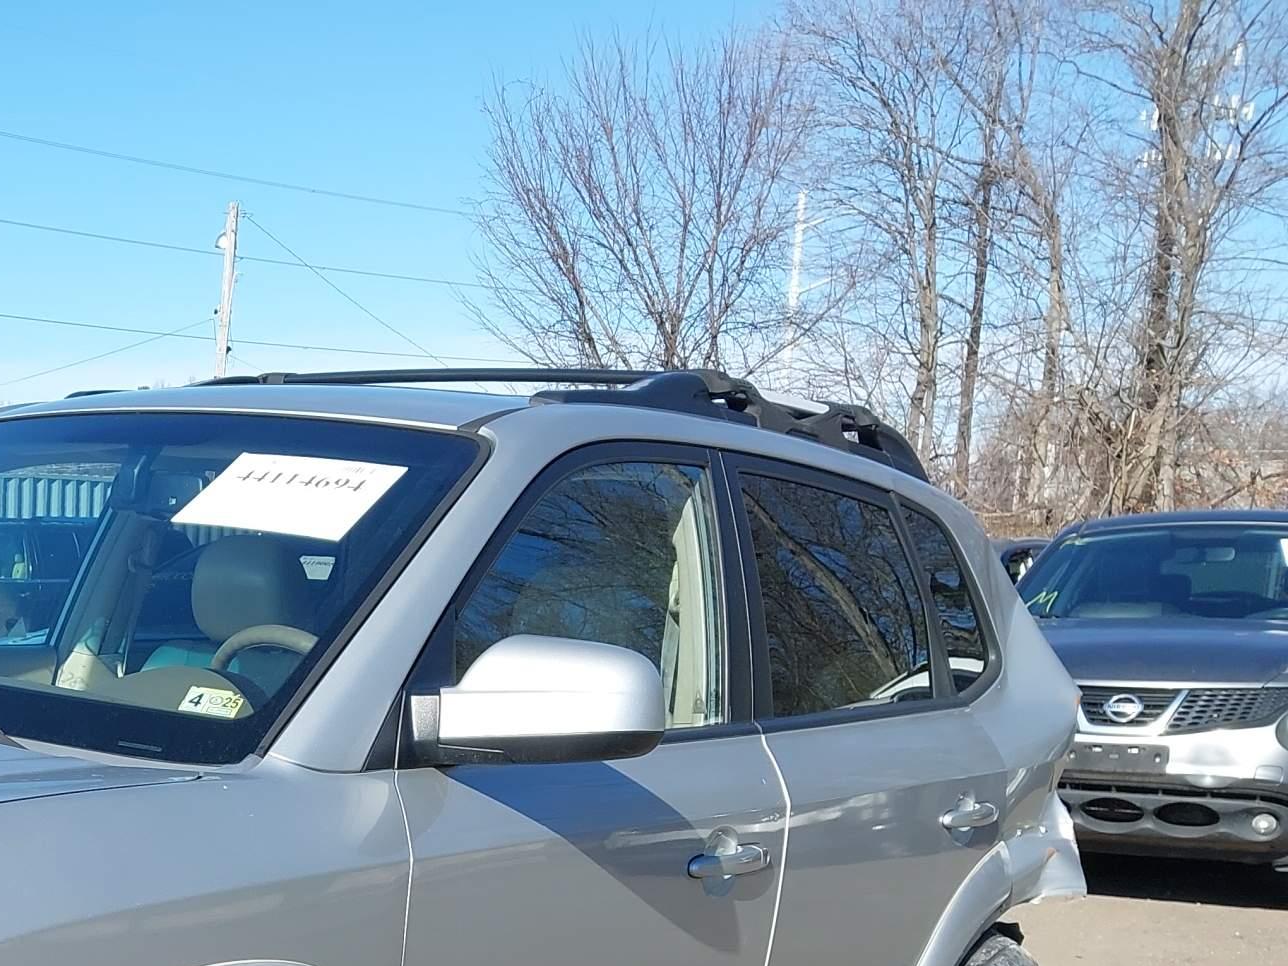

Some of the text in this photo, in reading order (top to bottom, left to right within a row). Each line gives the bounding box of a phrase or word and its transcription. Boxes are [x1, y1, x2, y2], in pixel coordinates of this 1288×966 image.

[237, 470, 366, 491] 44114694
[187, 693, 242, 709] 4 25
